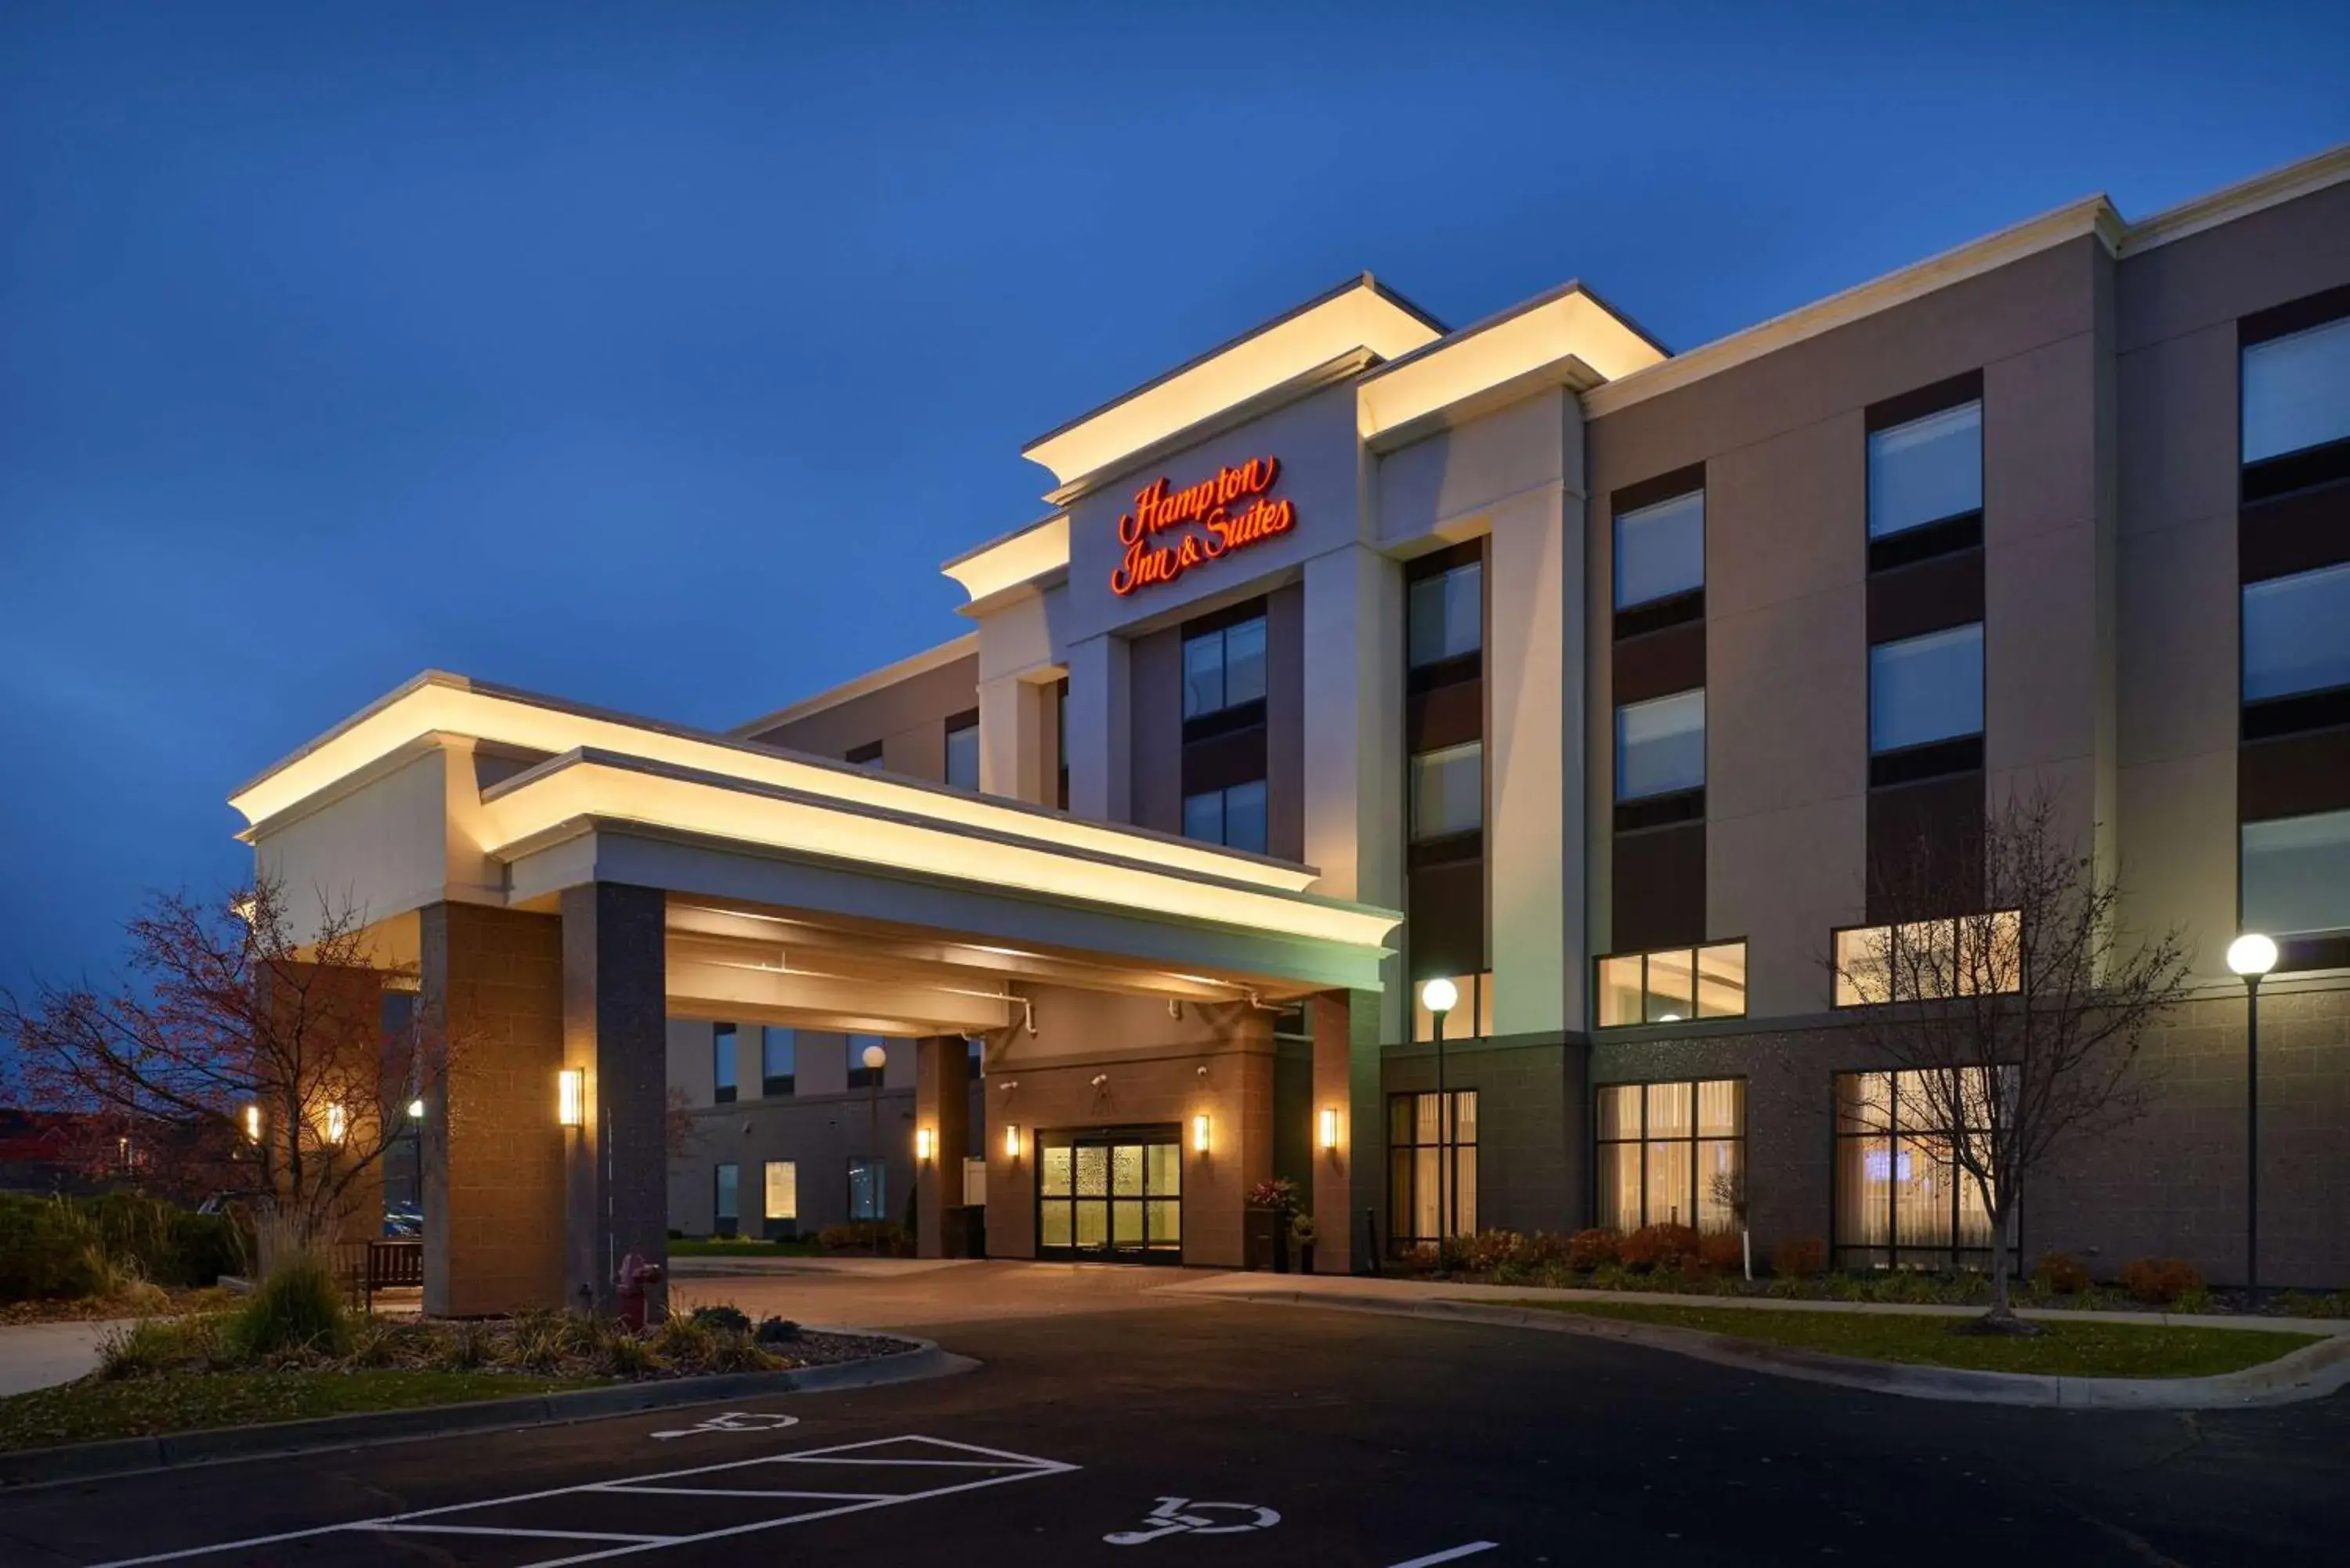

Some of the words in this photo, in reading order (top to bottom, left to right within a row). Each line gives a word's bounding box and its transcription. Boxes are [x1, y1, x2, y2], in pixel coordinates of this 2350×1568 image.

[1111, 539, 1181, 595] Inn
[1180, 534, 1202, 566] &
[1203, 498, 1293, 558] Suites
[1118, 454, 1277, 546] Hampton
